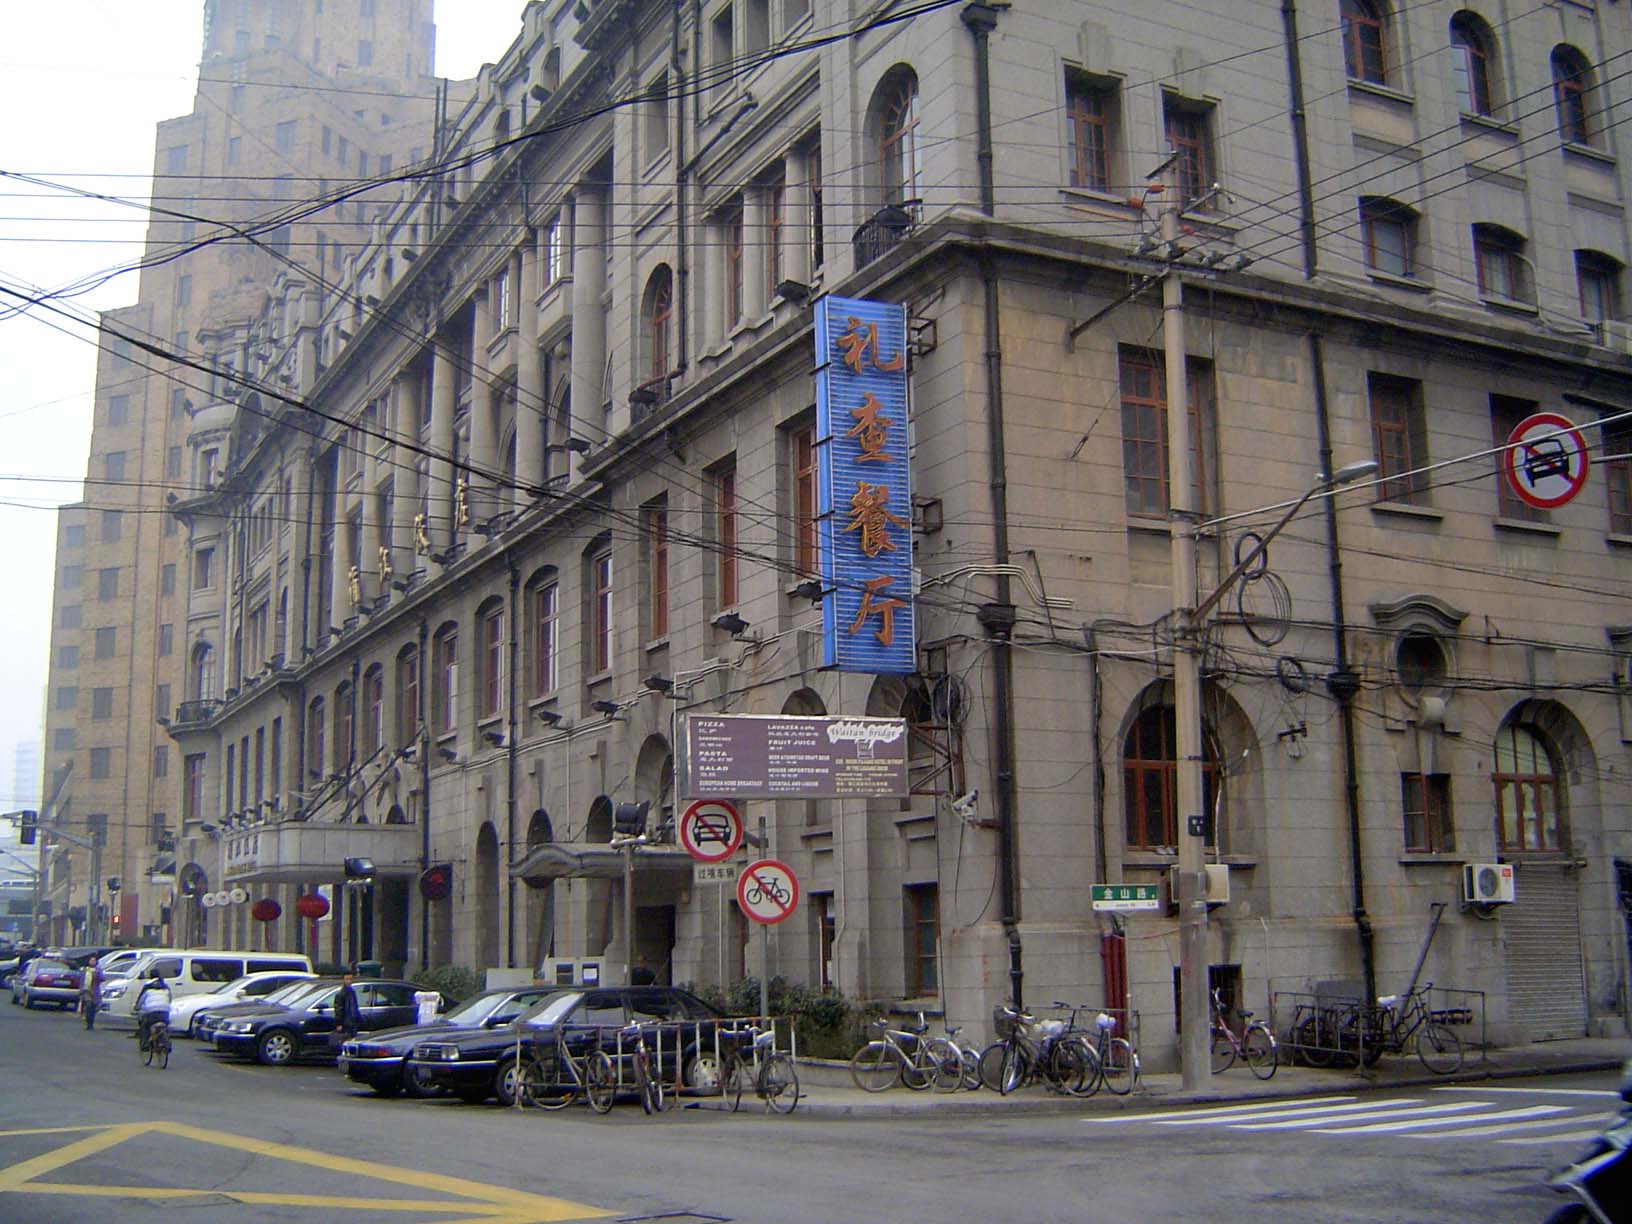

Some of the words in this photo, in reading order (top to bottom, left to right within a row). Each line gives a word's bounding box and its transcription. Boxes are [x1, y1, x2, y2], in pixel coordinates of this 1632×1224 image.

[835, 315, 909, 647] 礼查餐厅
[831, 726, 865, 737] Waitan
[1103, 887, 1147, 900] 金山路
